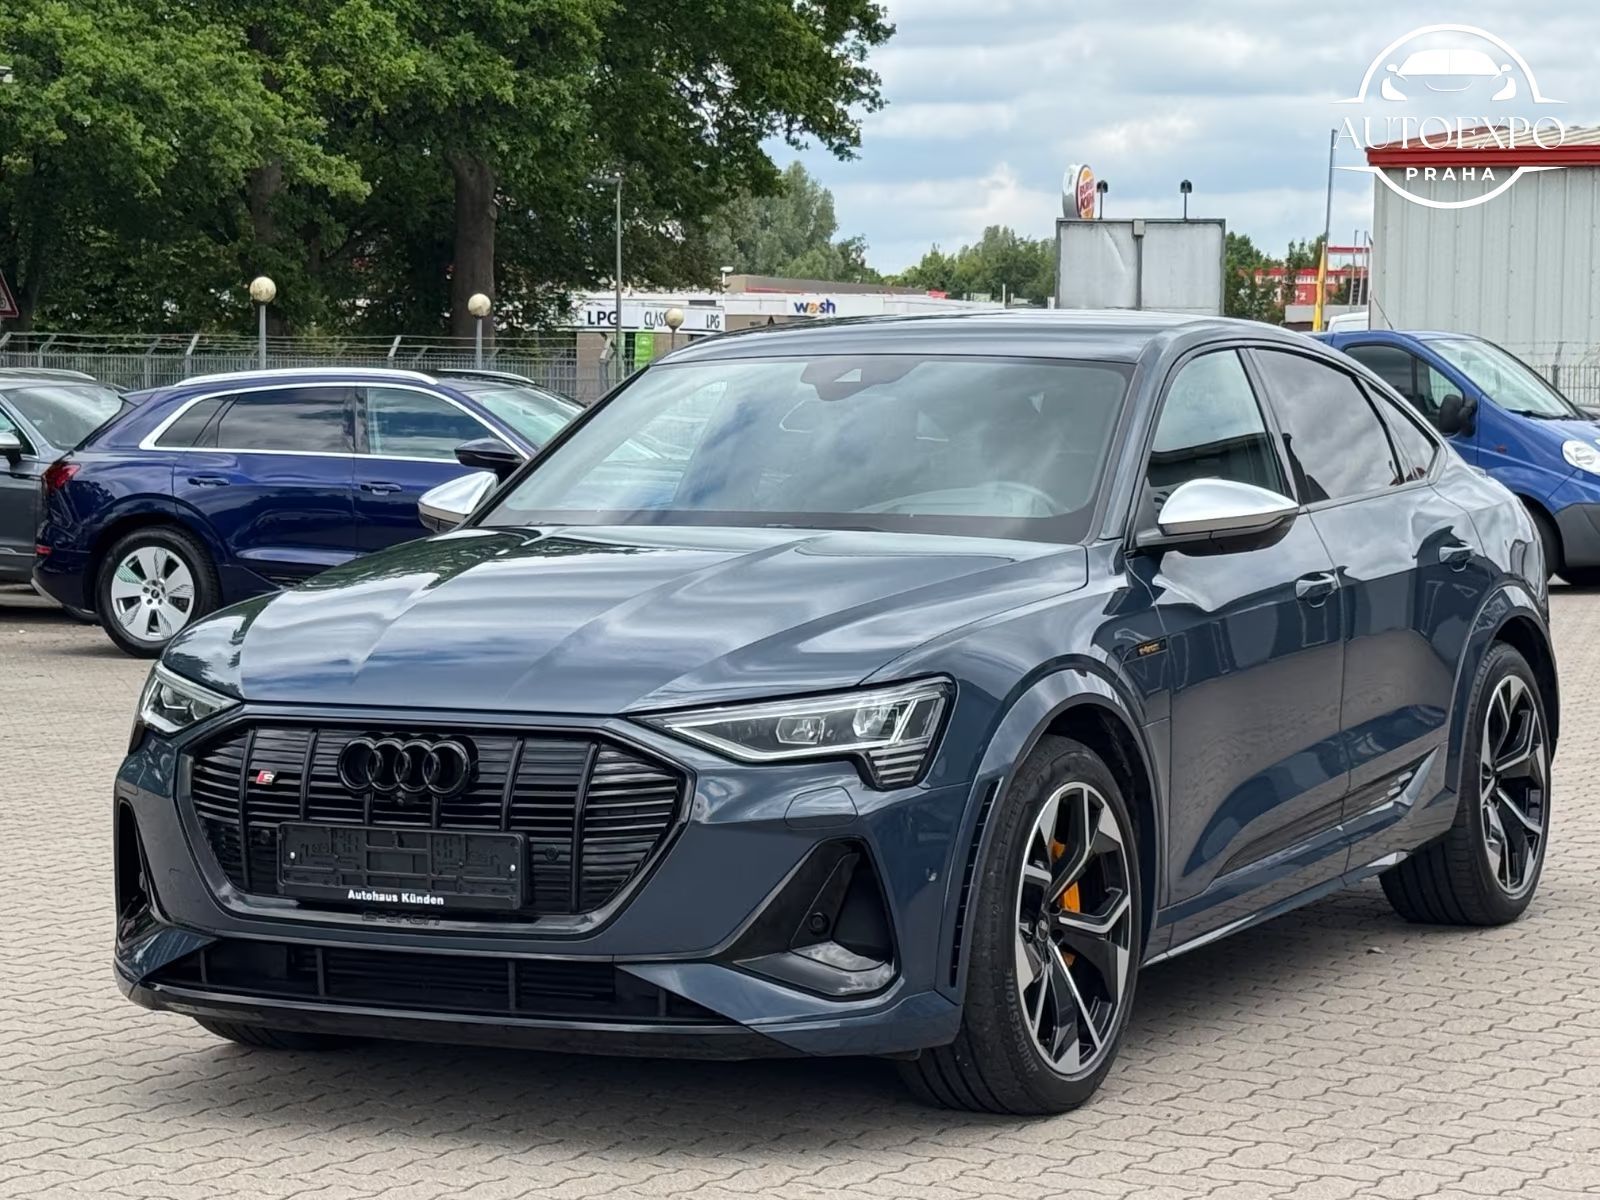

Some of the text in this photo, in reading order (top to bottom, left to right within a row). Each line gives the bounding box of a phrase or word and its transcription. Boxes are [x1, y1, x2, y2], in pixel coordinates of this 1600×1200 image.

[793, 298, 836, 314] wash
[587, 310, 617, 326] LPG
[706, 314, 721, 329] LPG
[347, 889, 445, 905] Autohaus Künden
